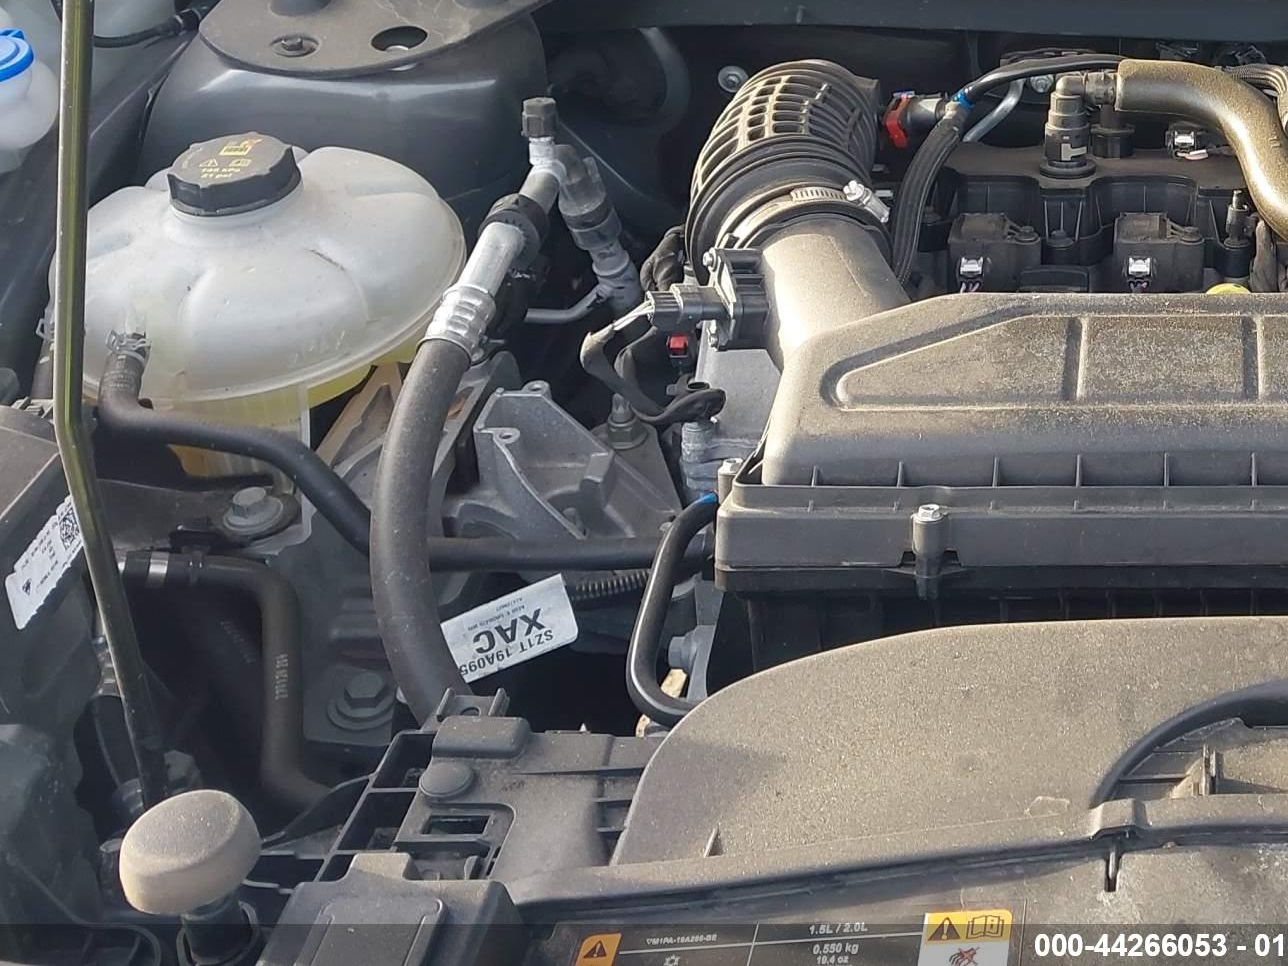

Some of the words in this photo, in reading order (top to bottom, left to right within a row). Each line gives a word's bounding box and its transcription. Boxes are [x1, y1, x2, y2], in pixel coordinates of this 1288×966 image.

[472, 608, 545, 654] XAC
[518, 629, 554, 653] SZ1T
[460, 648, 513, 675] 19A095
[809, 924, 833, 935] 1.5L
[843, 922, 868, 933] 2.0L
[812, 942, 842, 955] 0.550
[845, 942, 859, 955] kg
[837, 955, 849, 964] oz
